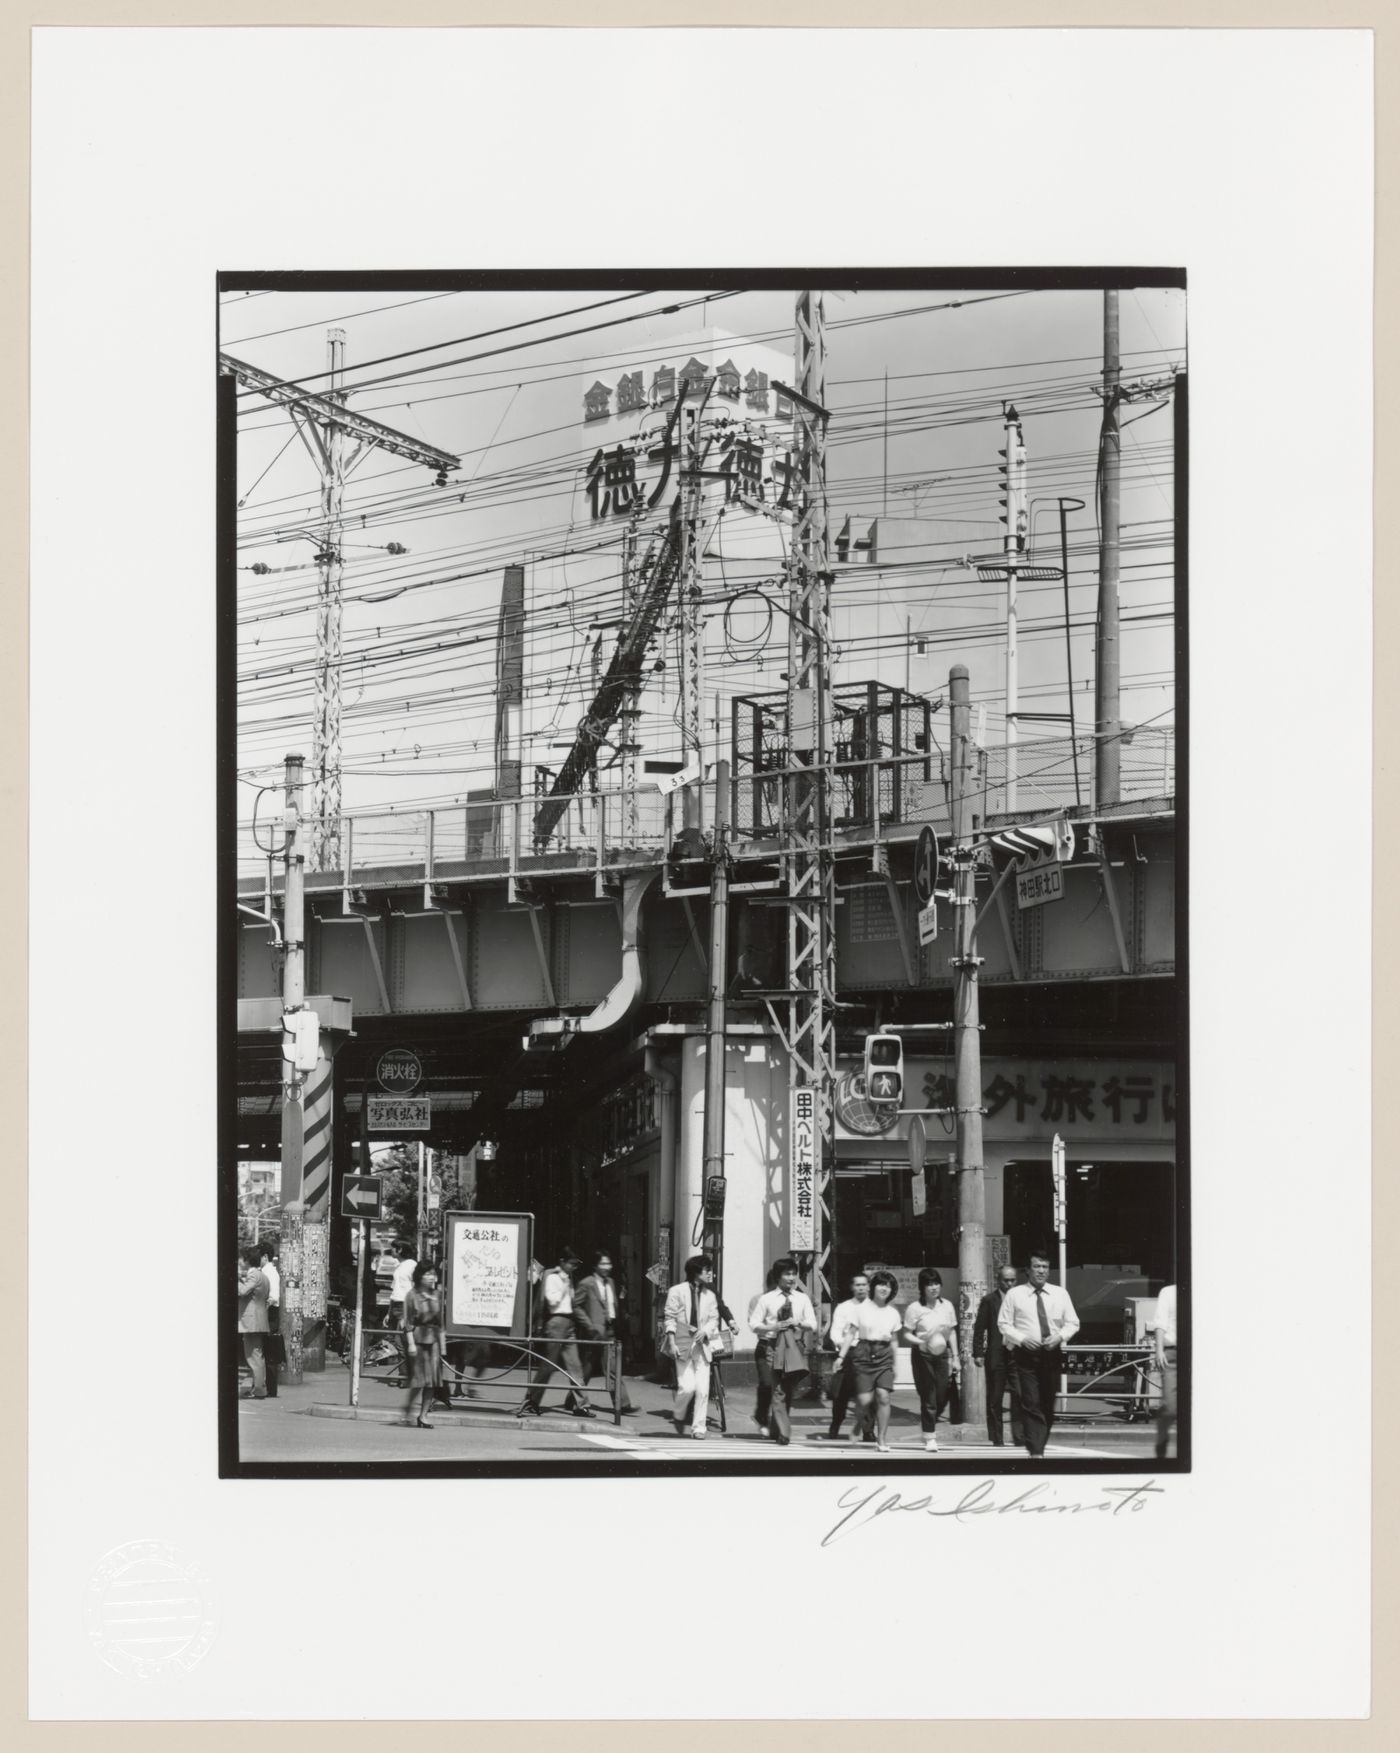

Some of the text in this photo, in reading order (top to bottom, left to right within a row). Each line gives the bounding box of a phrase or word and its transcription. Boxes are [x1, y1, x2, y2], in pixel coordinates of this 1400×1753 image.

[1019, 870, 1061, 901] 神田駅北口
[380, 1062, 418, 1080] 消火栓
[370, 1107, 429, 1121] 写真弘社
